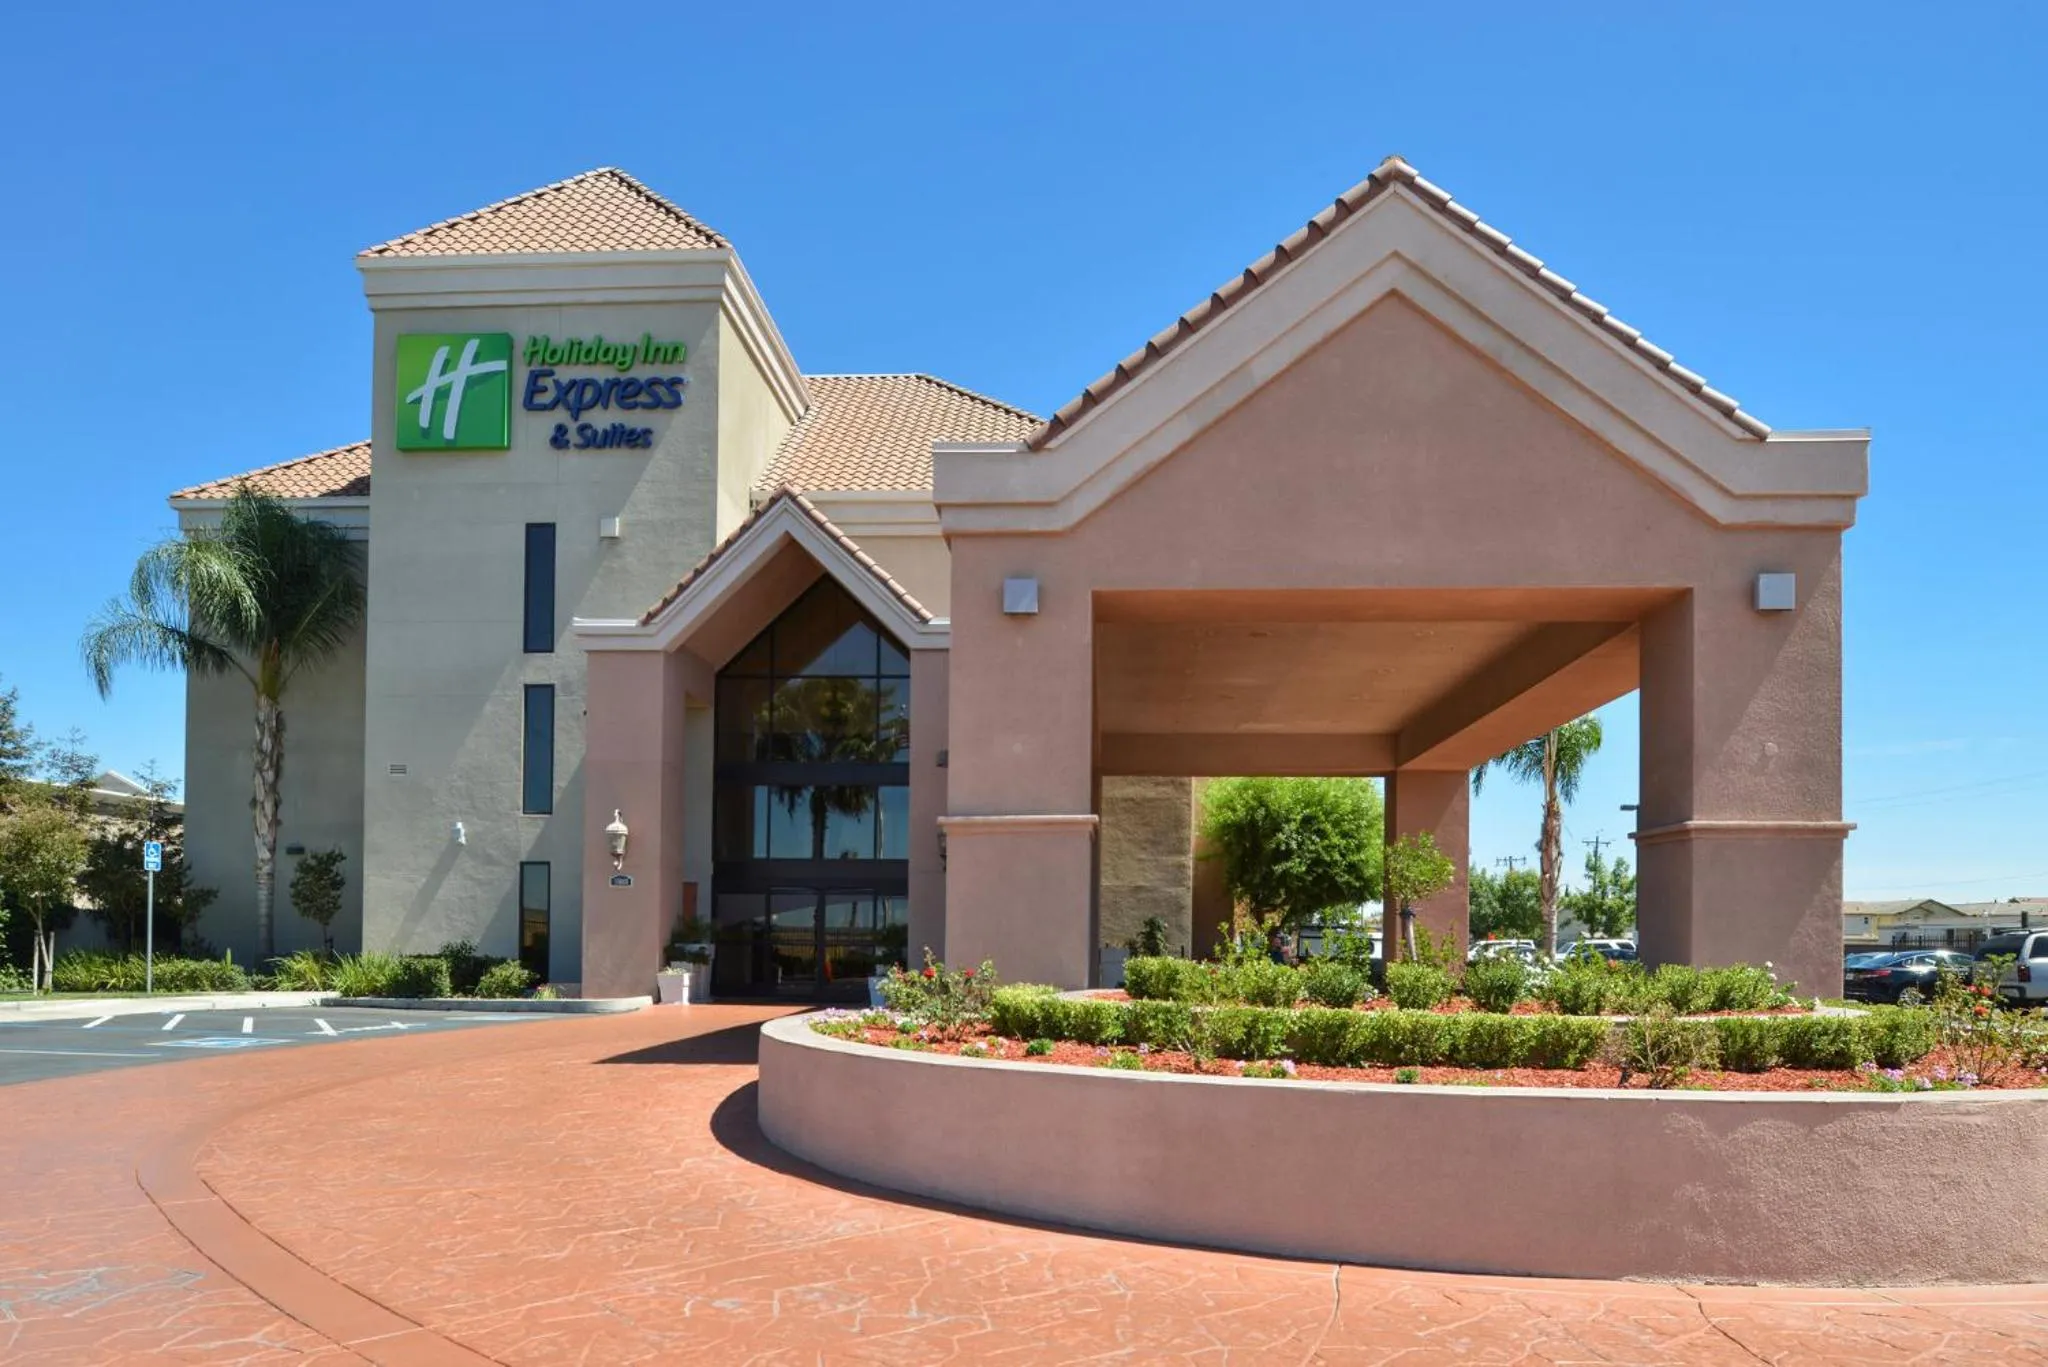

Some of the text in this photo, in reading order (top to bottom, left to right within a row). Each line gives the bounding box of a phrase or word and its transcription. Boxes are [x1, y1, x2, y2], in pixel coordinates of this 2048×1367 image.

[523, 332, 687, 372] Holiday Inn
[405, 338, 507, 440] H
[522, 368, 685, 422] Express
[549, 422, 653, 449] & Suites
